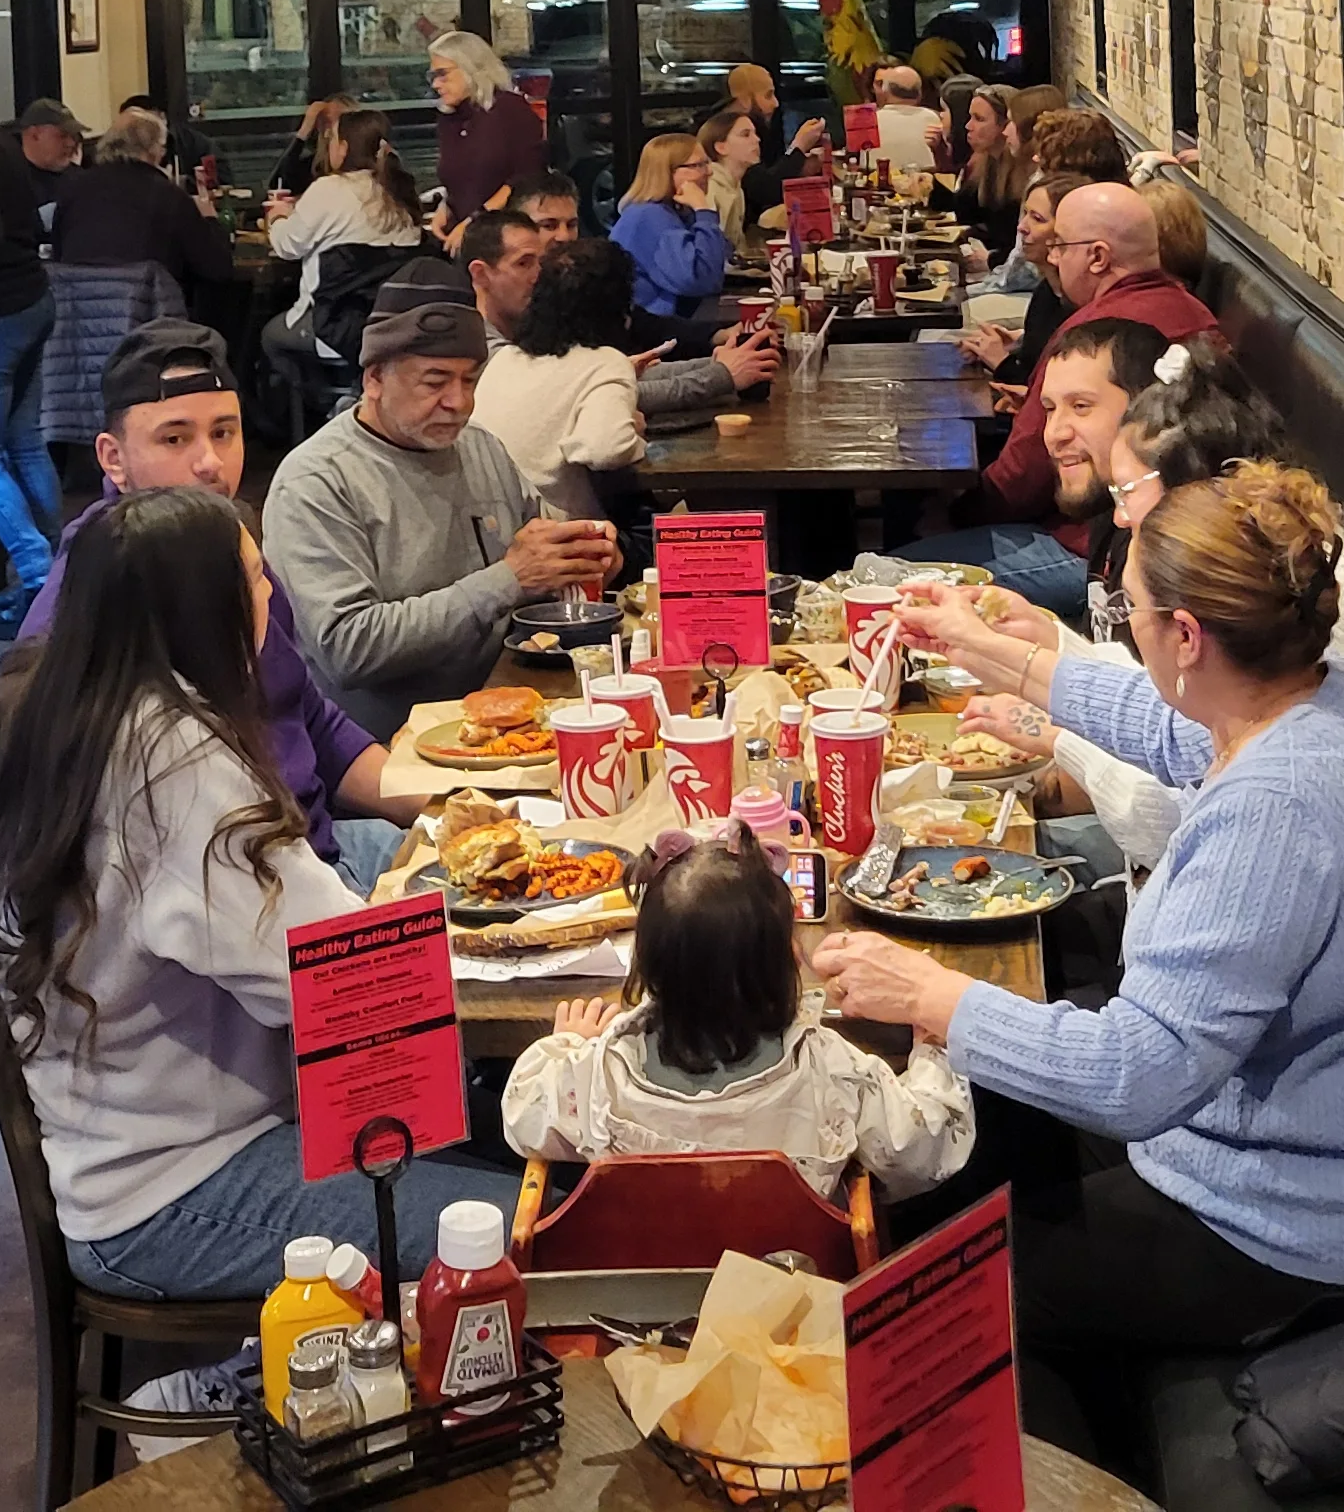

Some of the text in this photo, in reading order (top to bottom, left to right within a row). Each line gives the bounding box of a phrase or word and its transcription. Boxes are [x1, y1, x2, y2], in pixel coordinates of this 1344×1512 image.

[825, 751, 846, 843] Clucker's
[295, 937, 351, 965] Healthy
[354, 925, 400, 950] Eating
[403, 914, 443, 935] Guide
[457, 1362, 505, 1380] TOMATO
